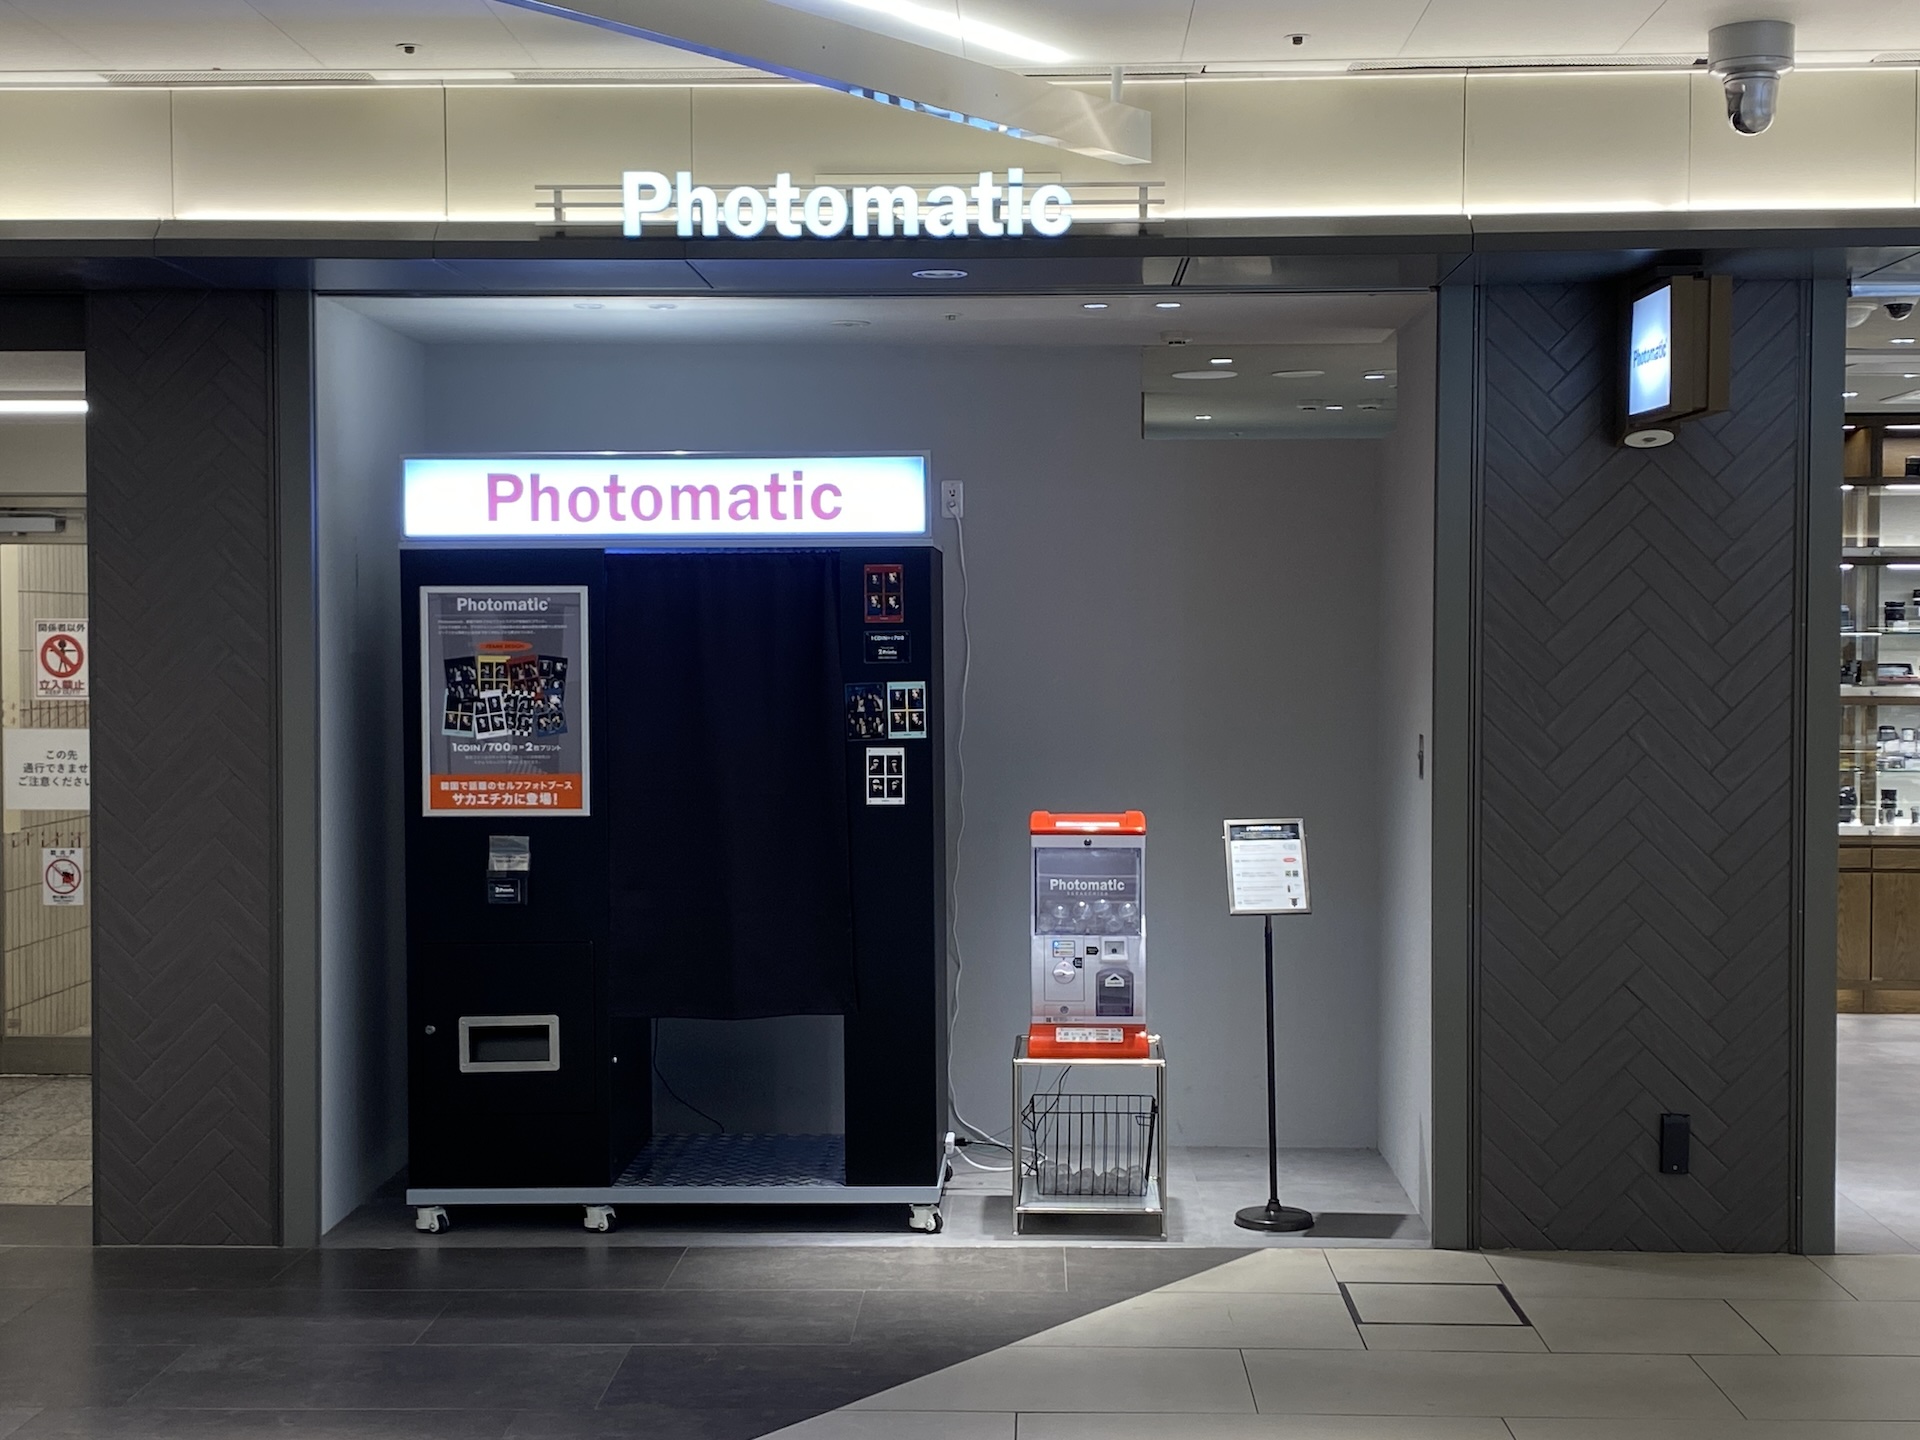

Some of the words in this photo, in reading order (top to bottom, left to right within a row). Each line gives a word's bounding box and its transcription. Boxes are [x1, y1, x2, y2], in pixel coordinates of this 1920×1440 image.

[621, 168, 1074, 238] Photomatic
[1632, 338, 1668, 369] Photomatic
[486, 470, 843, 523] Photomatic
[457, 597, 549, 612] Photomatic
[38, 623, 86, 632] 関係者以外
[39, 679, 86, 691] 立入禁止
[46, 750, 78, 760] この先
[1049, 878, 1125, 891] Photomatic
